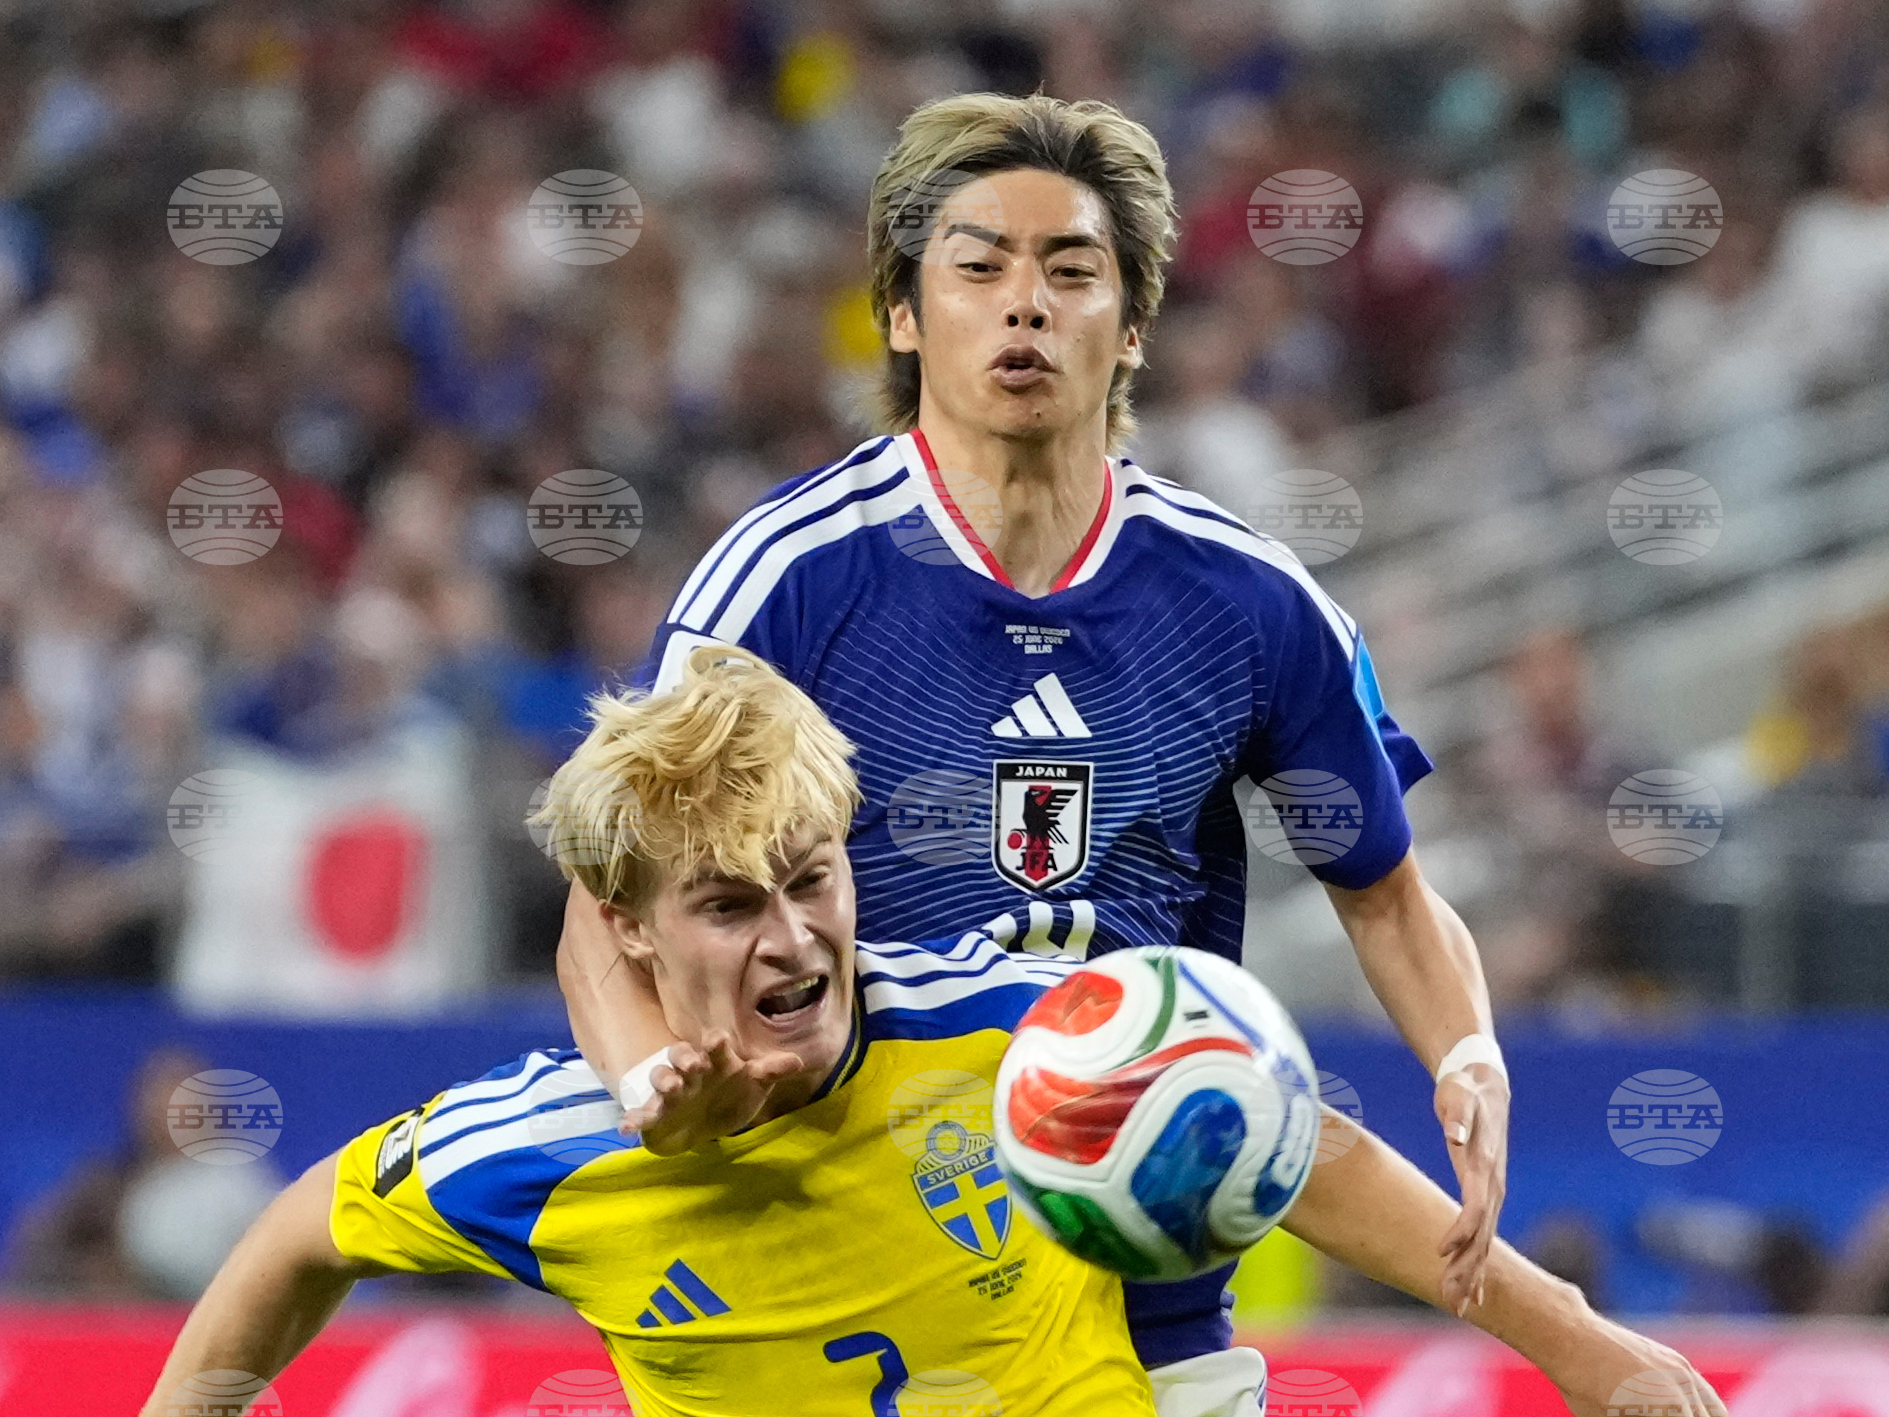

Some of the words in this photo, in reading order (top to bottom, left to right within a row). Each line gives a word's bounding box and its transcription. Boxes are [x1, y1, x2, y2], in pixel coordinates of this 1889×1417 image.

[1015, 766, 1068, 778] JAPAN
[1015, 852, 1058, 872] JFA
[927, 1151, 988, 1185] SVERIGE
